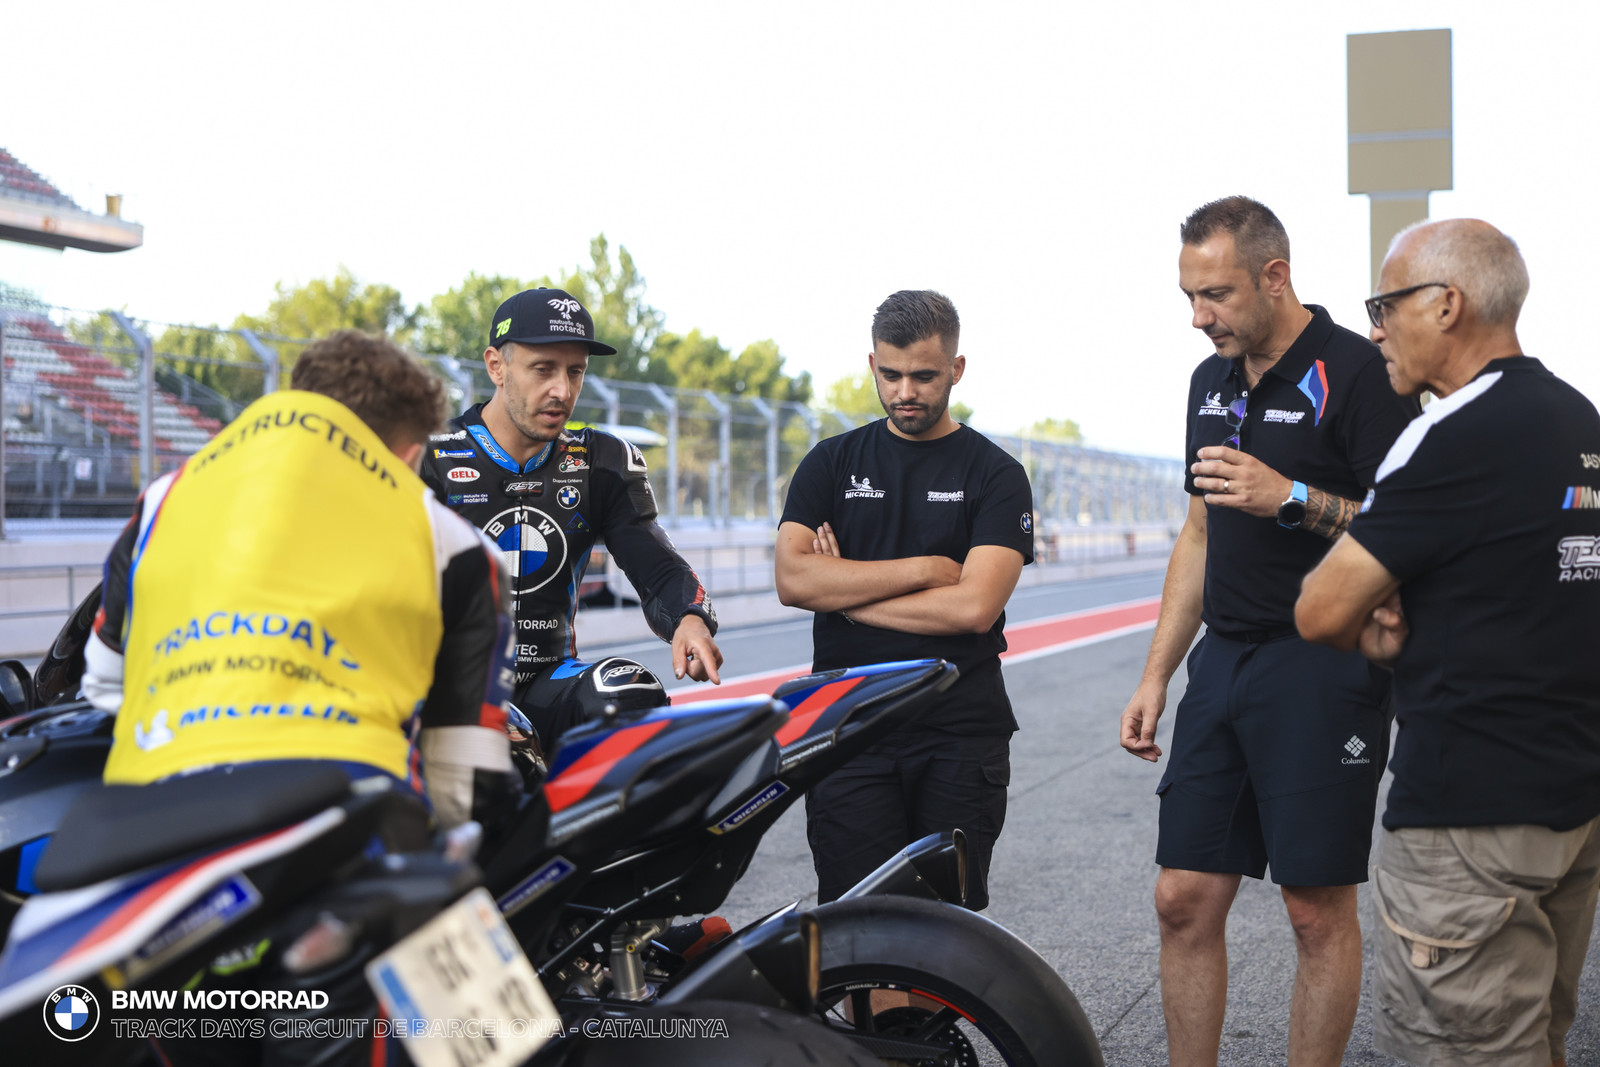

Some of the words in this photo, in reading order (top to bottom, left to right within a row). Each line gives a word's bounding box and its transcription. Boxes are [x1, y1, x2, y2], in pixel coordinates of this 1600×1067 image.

[495, 317, 512, 339] 78
[549, 324, 586, 337] motards
[451, 471, 477, 479] BELL
[505, 481, 543, 492] RST
[844, 491, 885, 499] MICHELIN
[489, 510, 556, 537] BMW
[512, 618, 559, 630] TORRAD
[732, 787, 778, 823] MICHELIN
